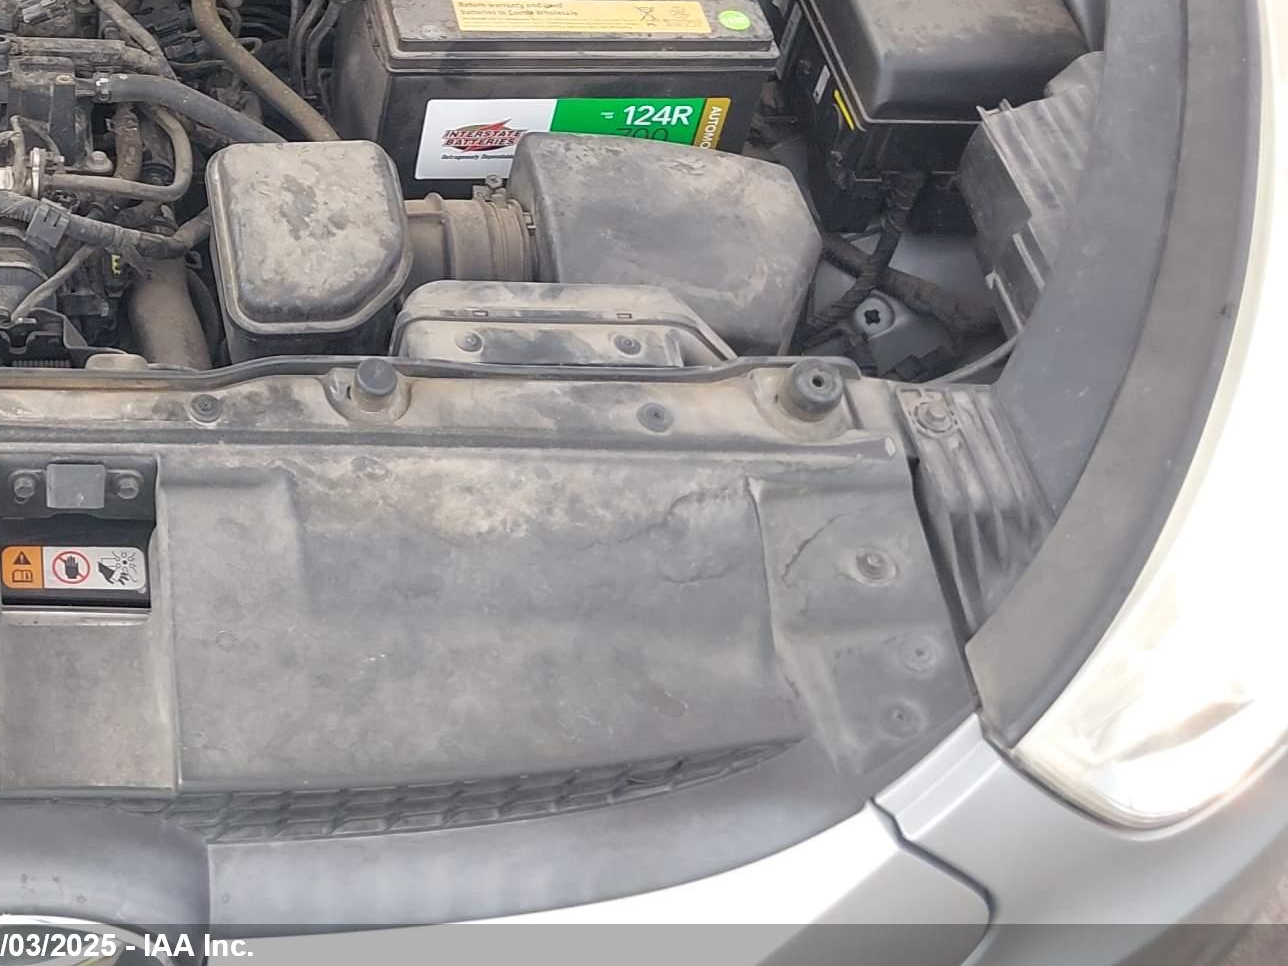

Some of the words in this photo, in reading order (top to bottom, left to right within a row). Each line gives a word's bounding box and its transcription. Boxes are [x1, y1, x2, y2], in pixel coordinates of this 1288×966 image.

[623, 105, 693, 126] 124R
[444, 130, 521, 138] INTERSTATE
[445, 138, 516, 146] BATTERIES
